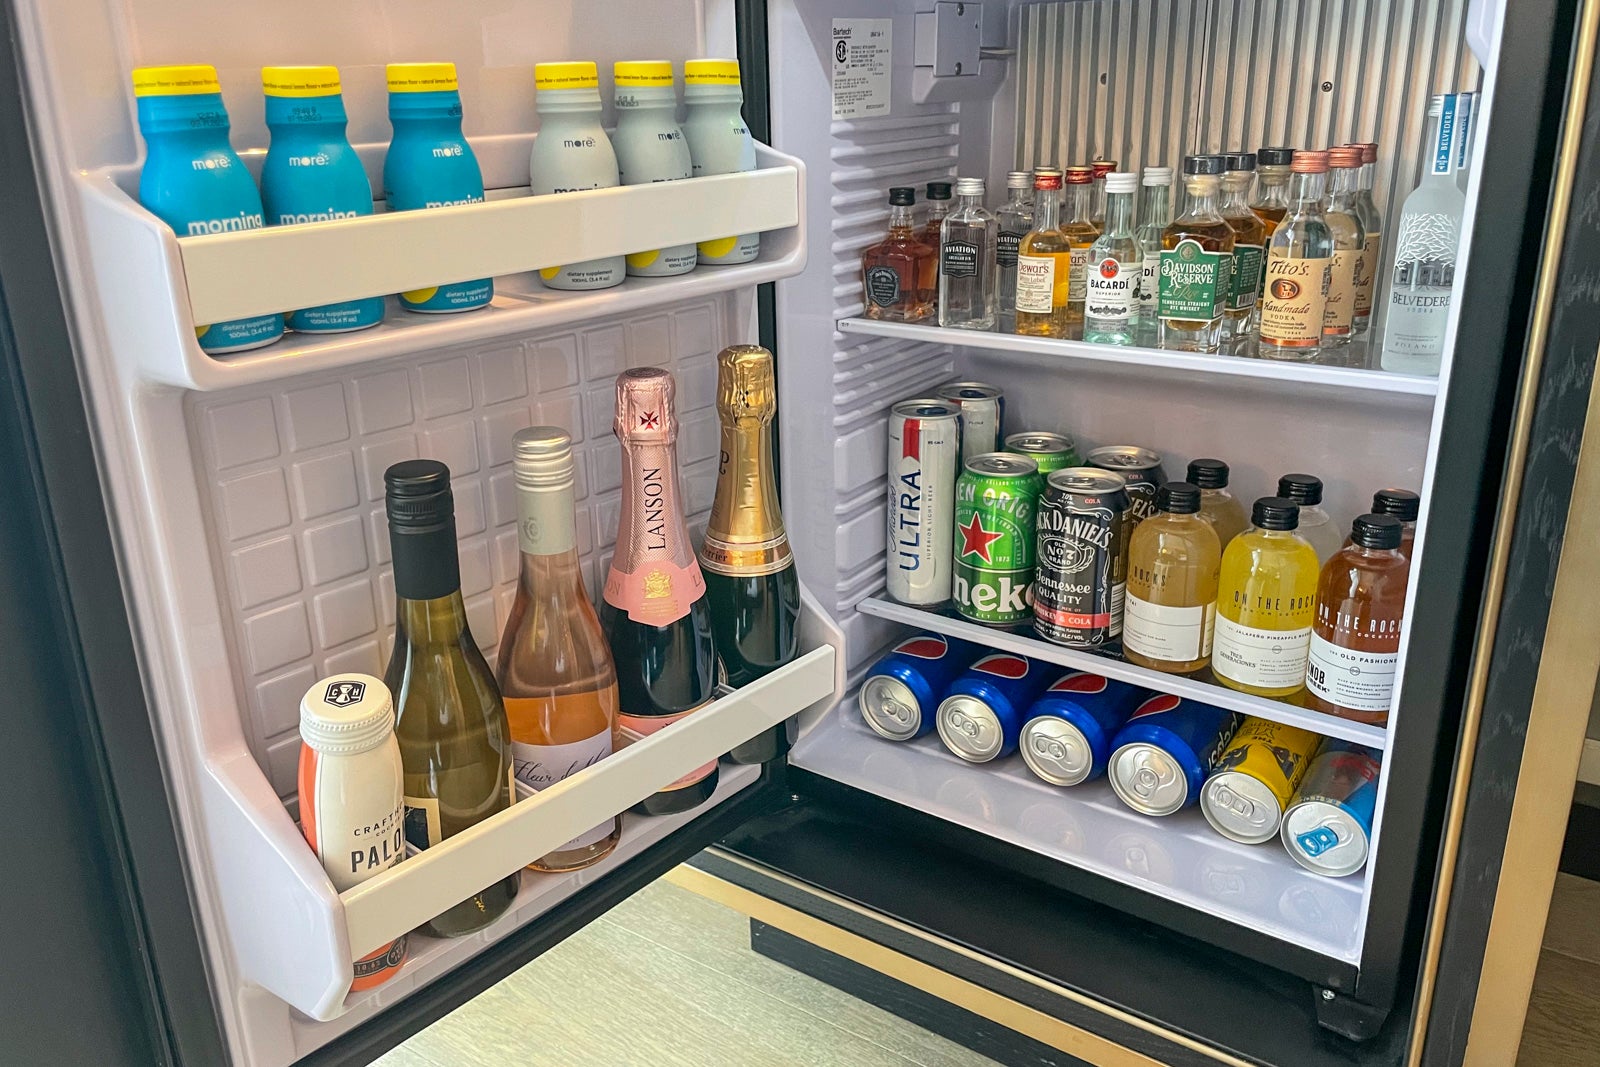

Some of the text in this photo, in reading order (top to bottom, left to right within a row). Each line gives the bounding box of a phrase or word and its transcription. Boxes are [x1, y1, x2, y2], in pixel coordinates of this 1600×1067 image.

[1440, 110, 1453, 150] BELVEDERE
[564, 137, 595, 148] more
[192, 156, 230, 170] more
[289, 153, 330, 166] more
[188, 211, 262, 236] morning
[945, 246, 976, 254] AVIATION
[1019, 261, 1049, 273] Dewar's
[1070, 255, 1086, 264] ar's
[1161, 258, 1216, 276] DAVIDSON
[586, 269, 612, 277] supplement
[1168, 270, 1214, 288] RESERVE
[1091, 278, 1129, 289] BACARDÍ
[1264, 301, 1311, 314] Handmade
[1393, 292, 1450, 307] BELVEDERE
[643, 467, 666, 551] LANSON
[899, 468, 921, 571] ULTRA
[1053, 510, 1114, 551] DANIEL'S
[1048, 555, 1071, 566] BRAND
[1065, 550, 1075, 559] 7
[1036, 566, 1091, 593] Tennessee
[1134, 565, 1166, 586] ROCKS
[1038, 587, 1082, 605] QUALITY
[1235, 590, 1248, 606] ON
[1258, 596, 1280, 610] THE
[1320, 602, 1329, 619] ON
[1337, 612, 1360, 630] THE
[1236, 630, 1264, 639] JALAPEÑO
[1220, 651, 1256, 668] GENERACIONES
[1230, 651, 1242, 659] TRES
[1308, 675, 1328, 693] CREEK
[514, 758, 554, 781] Fleur
